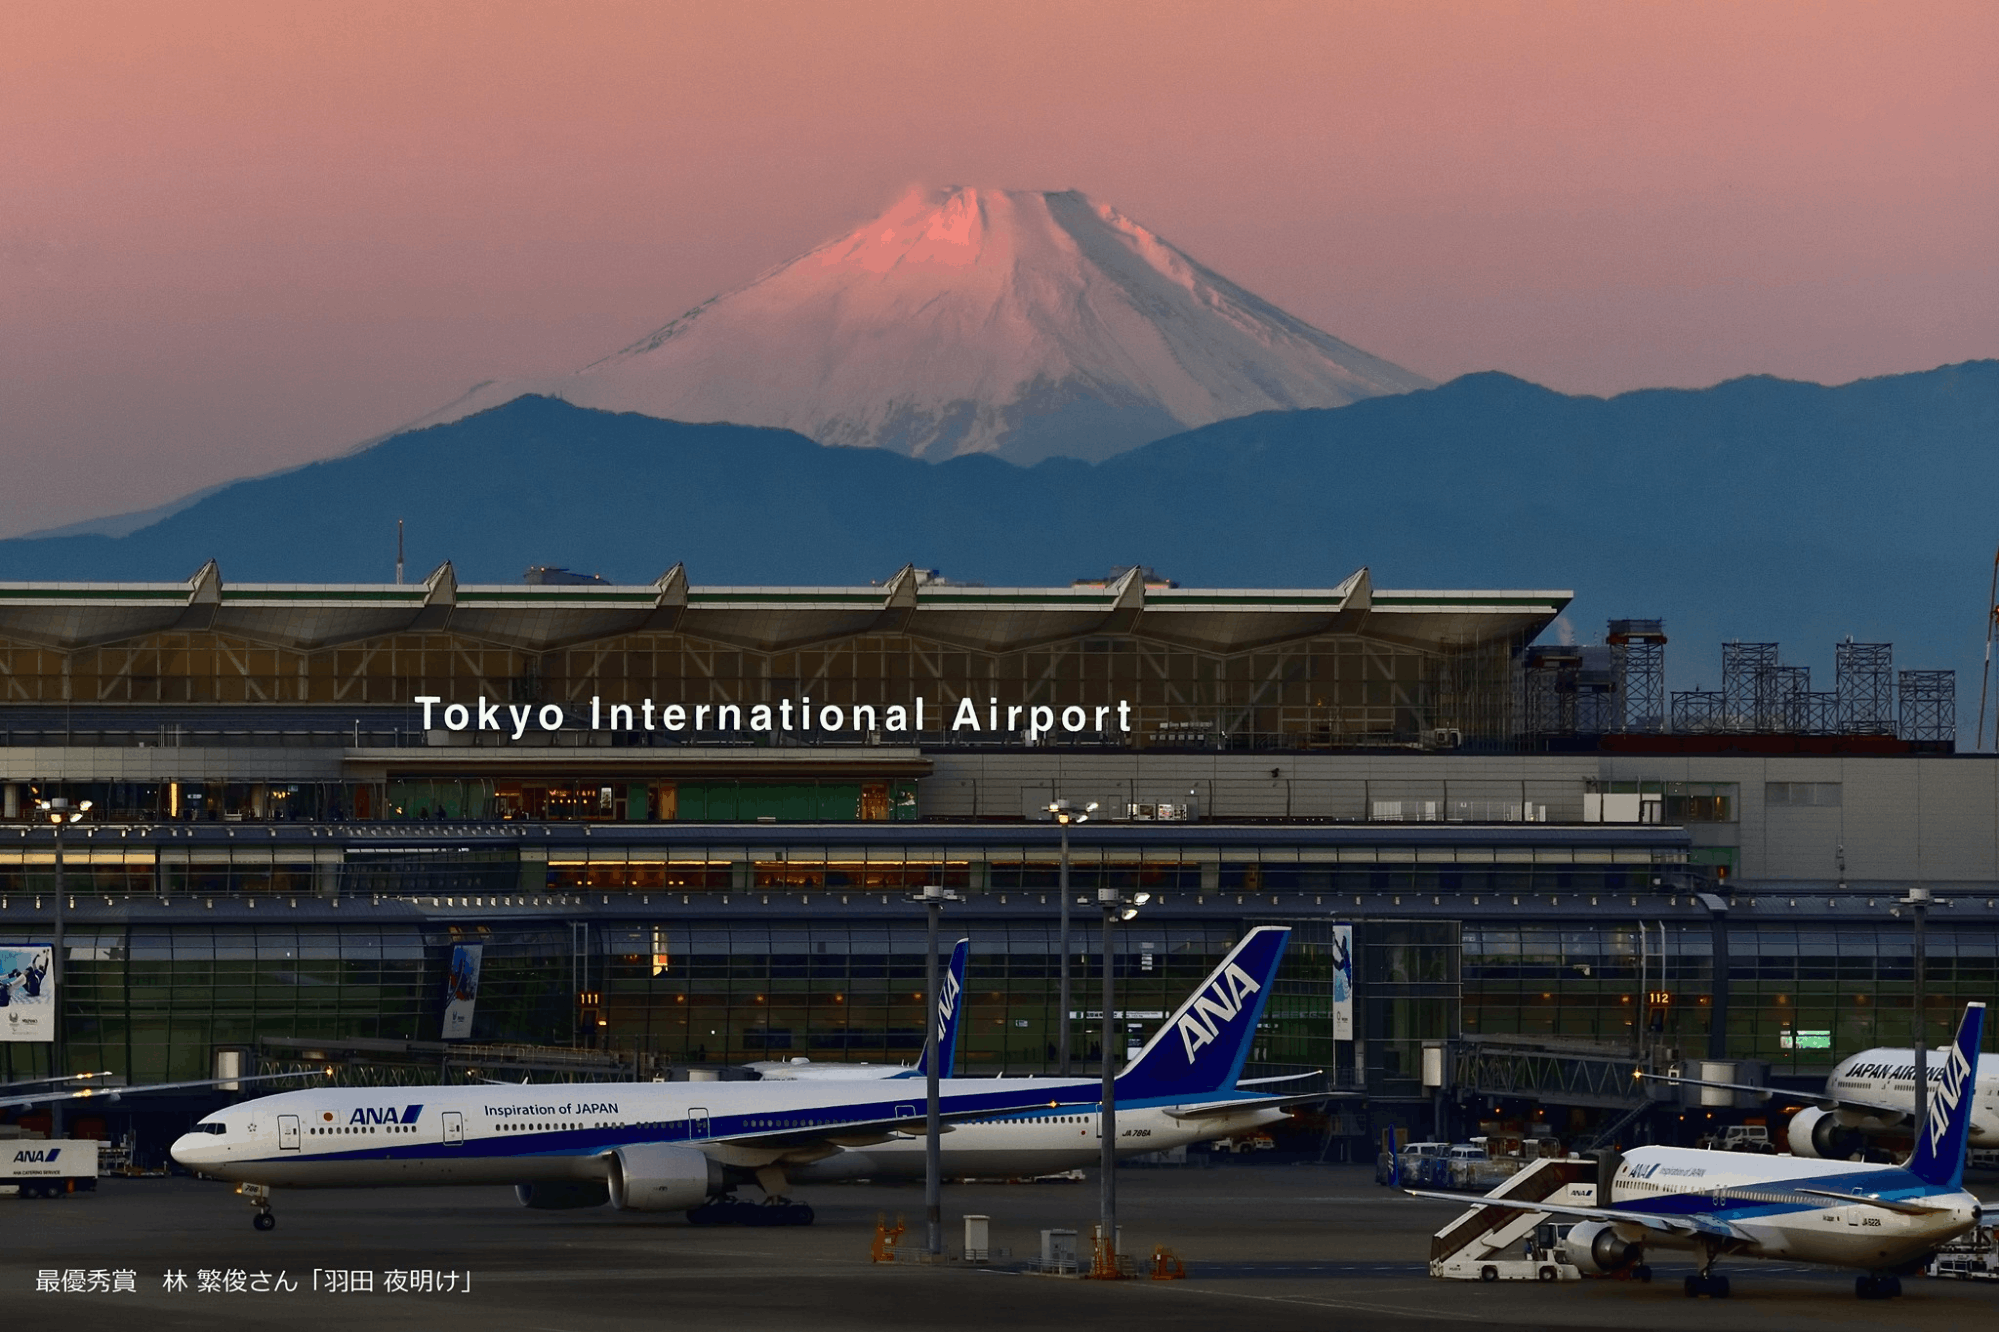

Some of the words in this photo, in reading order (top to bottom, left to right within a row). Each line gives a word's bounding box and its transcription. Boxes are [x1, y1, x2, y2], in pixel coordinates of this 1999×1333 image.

[414, 696, 564, 740] Tokyo
[592, 696, 923, 732] International
[952, 697, 1131, 741] Airport
[581, 993, 598, 1004] 111
[1650, 993, 1669, 1004] 112
[1177, 962, 1261, 1065] ANA
[1845, 1062, 1893, 1079] JAPAN
[1929, 1040, 1971, 1159] ANA
[349, 1107, 399, 1125] ANA
[484, 1104, 555, 1118] Inspiration
[558, 1103, 572, 1115] of
[575, 1102, 619, 1115] JAPAN
[13, 1150, 45, 1163] ANA
